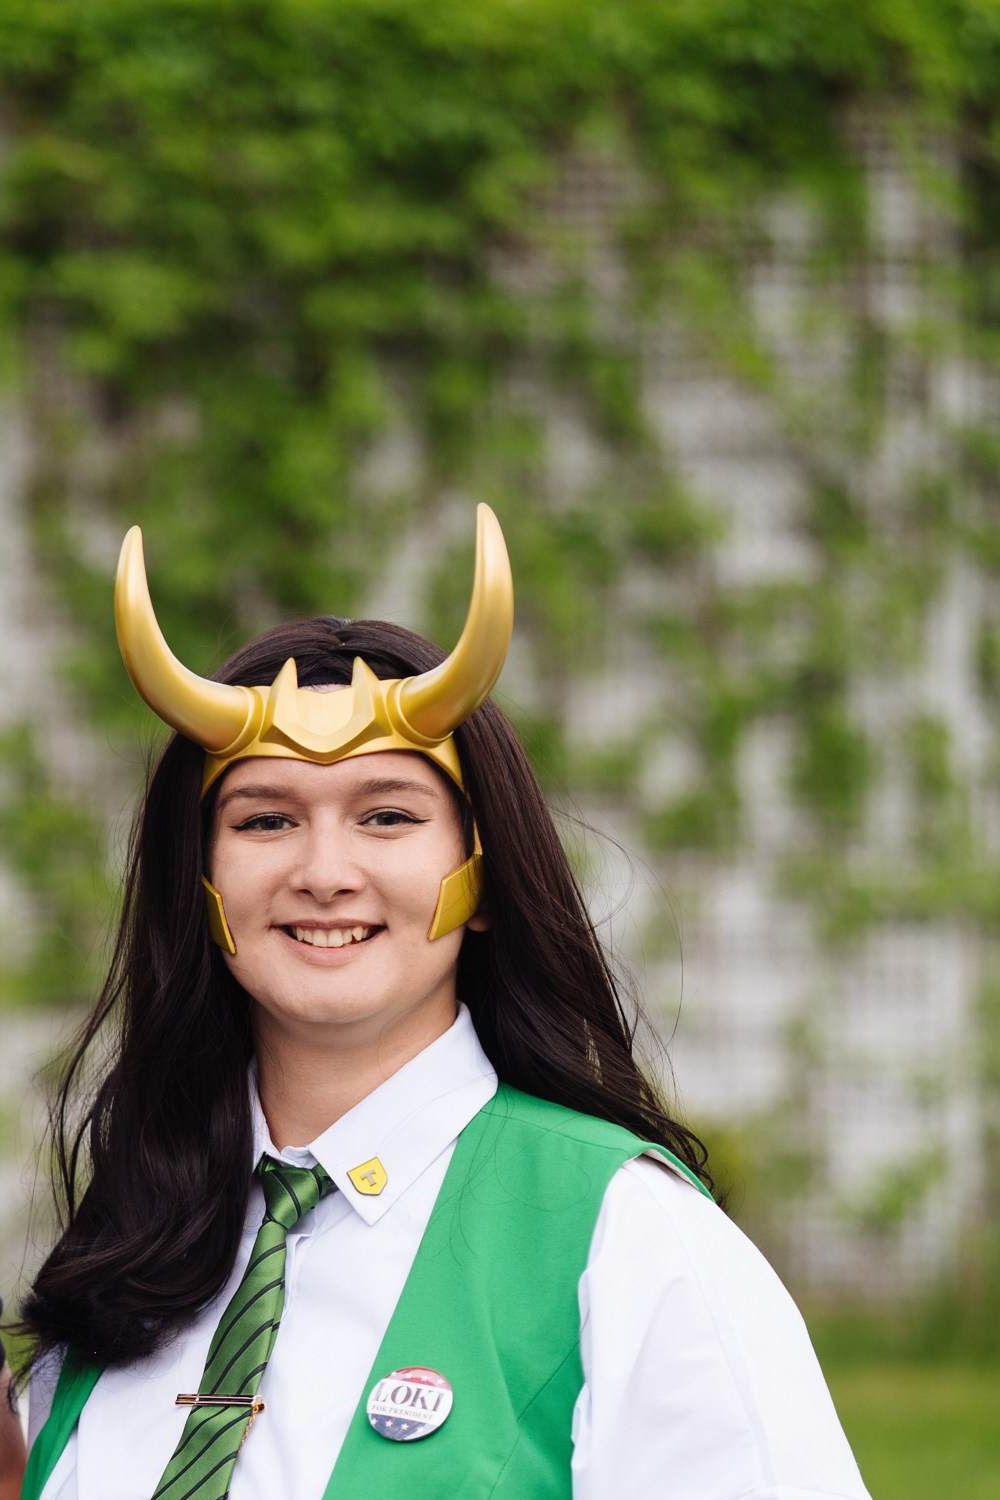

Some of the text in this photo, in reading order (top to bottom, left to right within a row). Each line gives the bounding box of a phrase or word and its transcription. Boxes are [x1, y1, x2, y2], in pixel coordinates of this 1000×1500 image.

[373, 1381, 446, 1412] LOKI
[372, 1404, 433, 1421] FOR PRESIDENT
